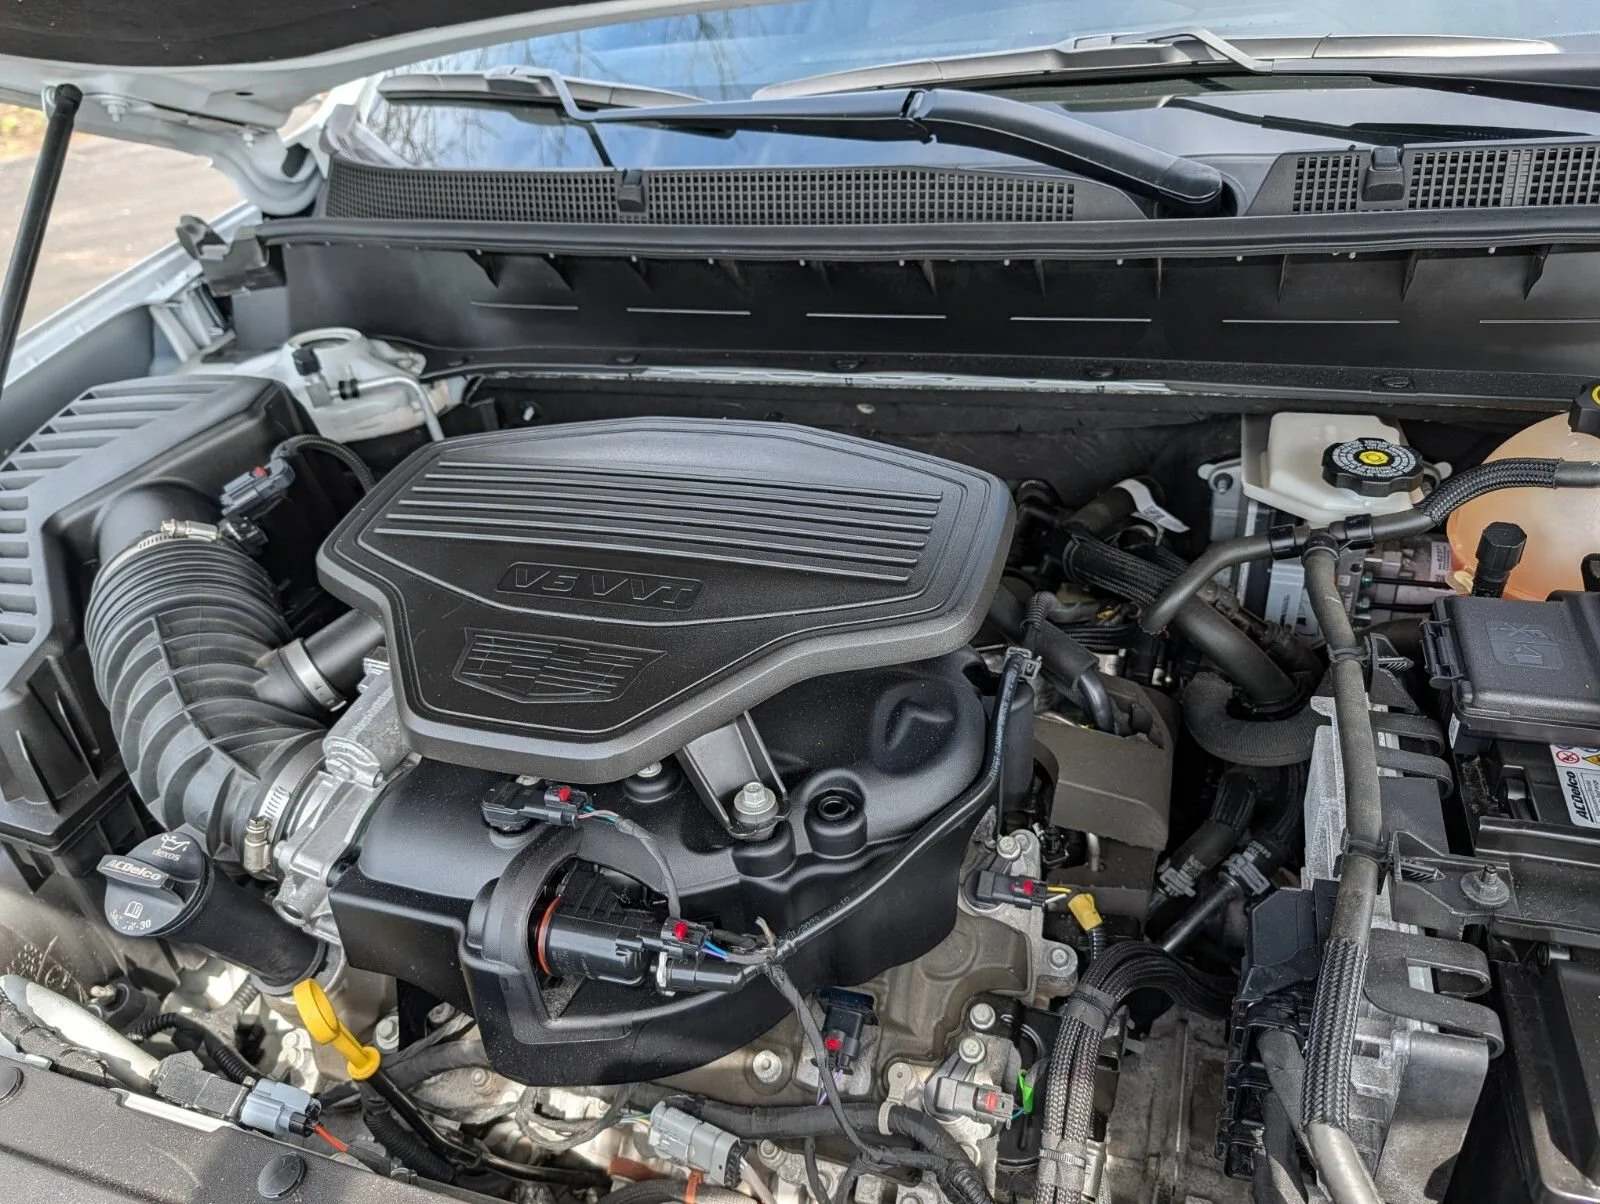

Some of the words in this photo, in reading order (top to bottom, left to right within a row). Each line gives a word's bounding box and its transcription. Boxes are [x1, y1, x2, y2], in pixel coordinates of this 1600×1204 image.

[514, 567, 580, 592] V6
[591, 574, 693, 605] VVT
[1566, 770, 1589, 820] ACDelco
[105, 859, 162, 881] ACDelco
[152, 848, 181, 862] dexos
